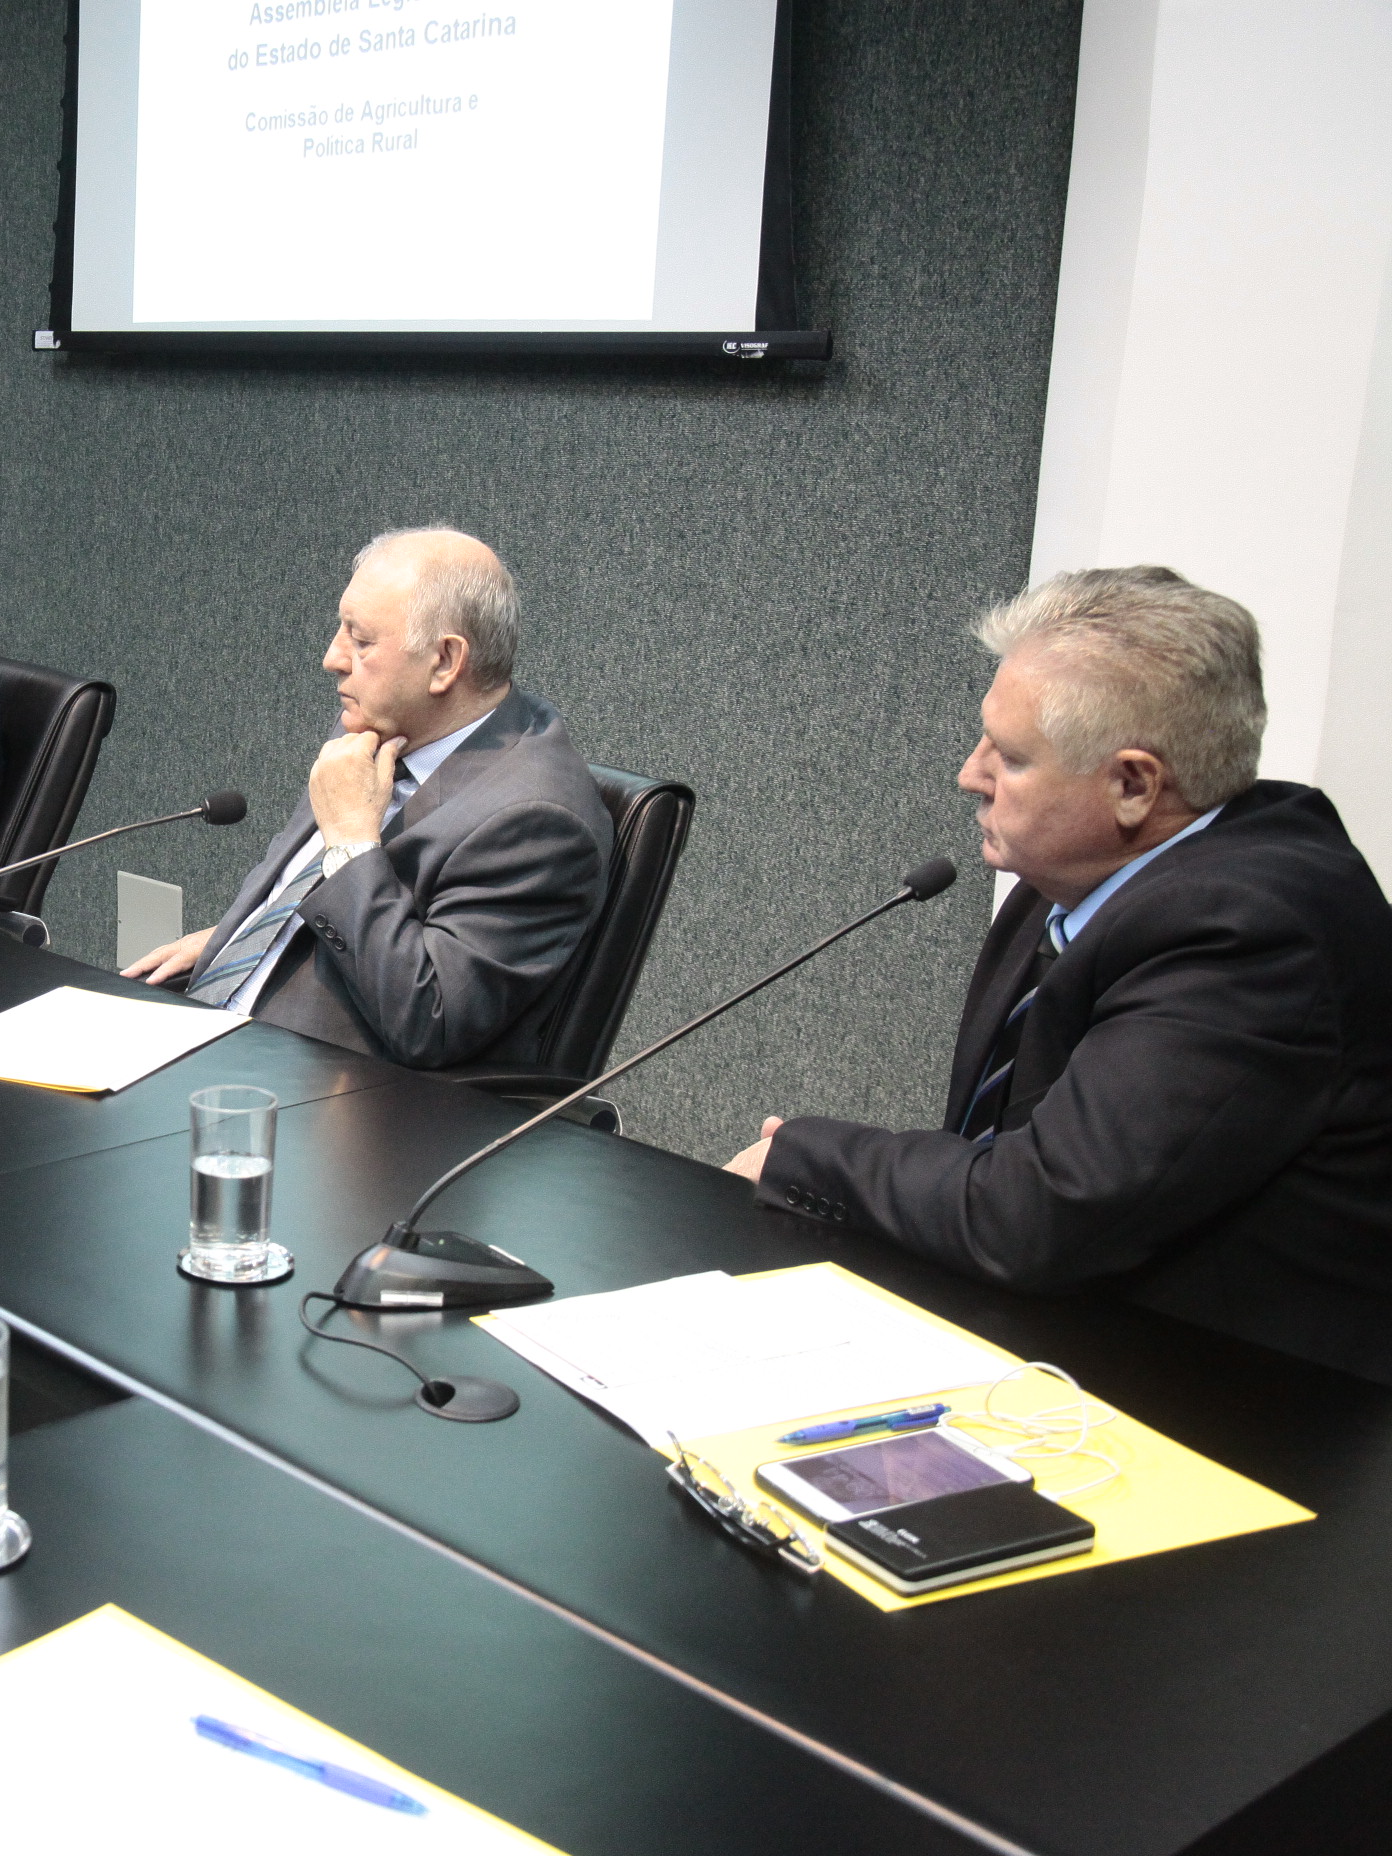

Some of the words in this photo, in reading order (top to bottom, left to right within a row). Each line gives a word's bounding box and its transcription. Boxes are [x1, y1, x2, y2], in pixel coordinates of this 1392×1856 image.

[228, 49, 248, 70] do
[256, 38, 321, 66] Estado
[329, 34, 351, 57] de
[358, 25, 416, 53] Santa
[424, 13, 516, 44] Catarina
[245, 106, 328, 132] Comissão
[334, 103, 354, 124] de
[361, 94, 462, 125] Agricultura
[468, 94, 478, 110] e
[372, 128, 418, 152] Rural
